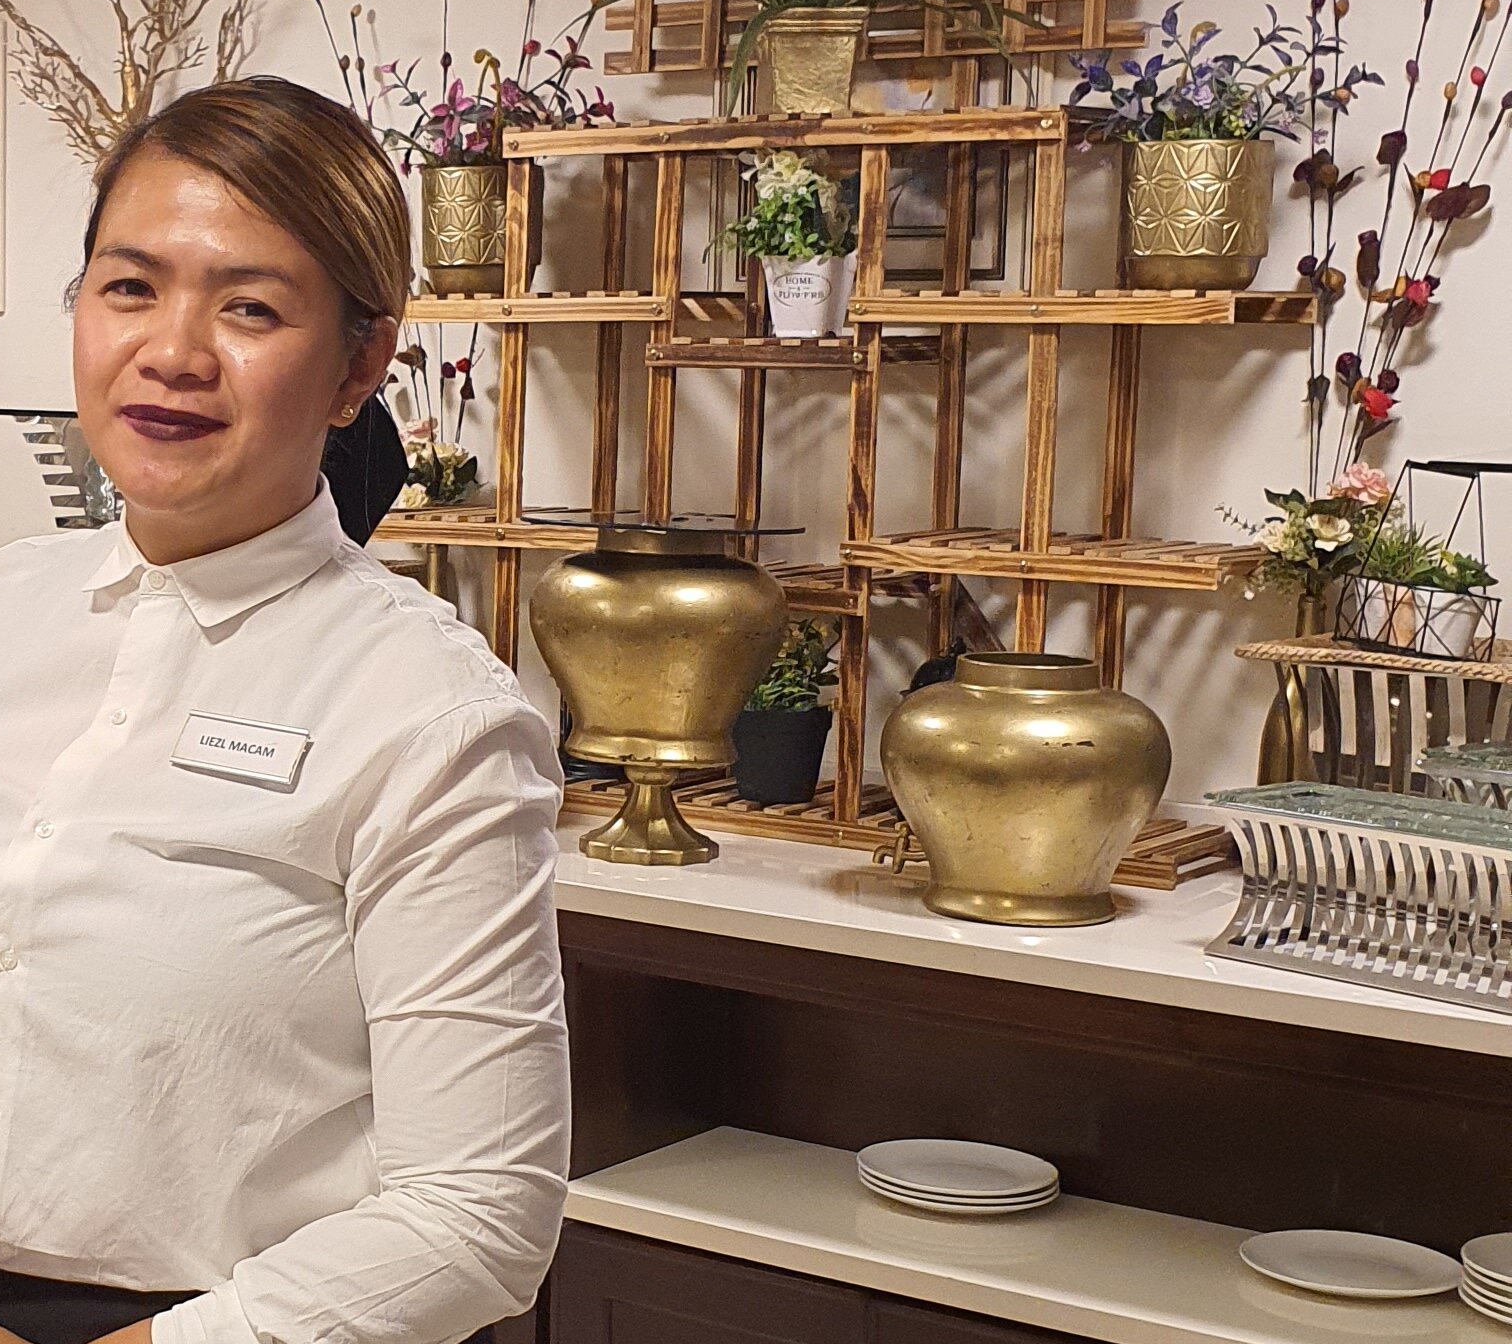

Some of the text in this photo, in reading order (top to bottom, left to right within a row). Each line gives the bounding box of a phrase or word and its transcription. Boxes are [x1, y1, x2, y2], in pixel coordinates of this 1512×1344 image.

[785, 276, 814, 285] HOME
[199, 735, 276, 758] LIEZL MACAM
